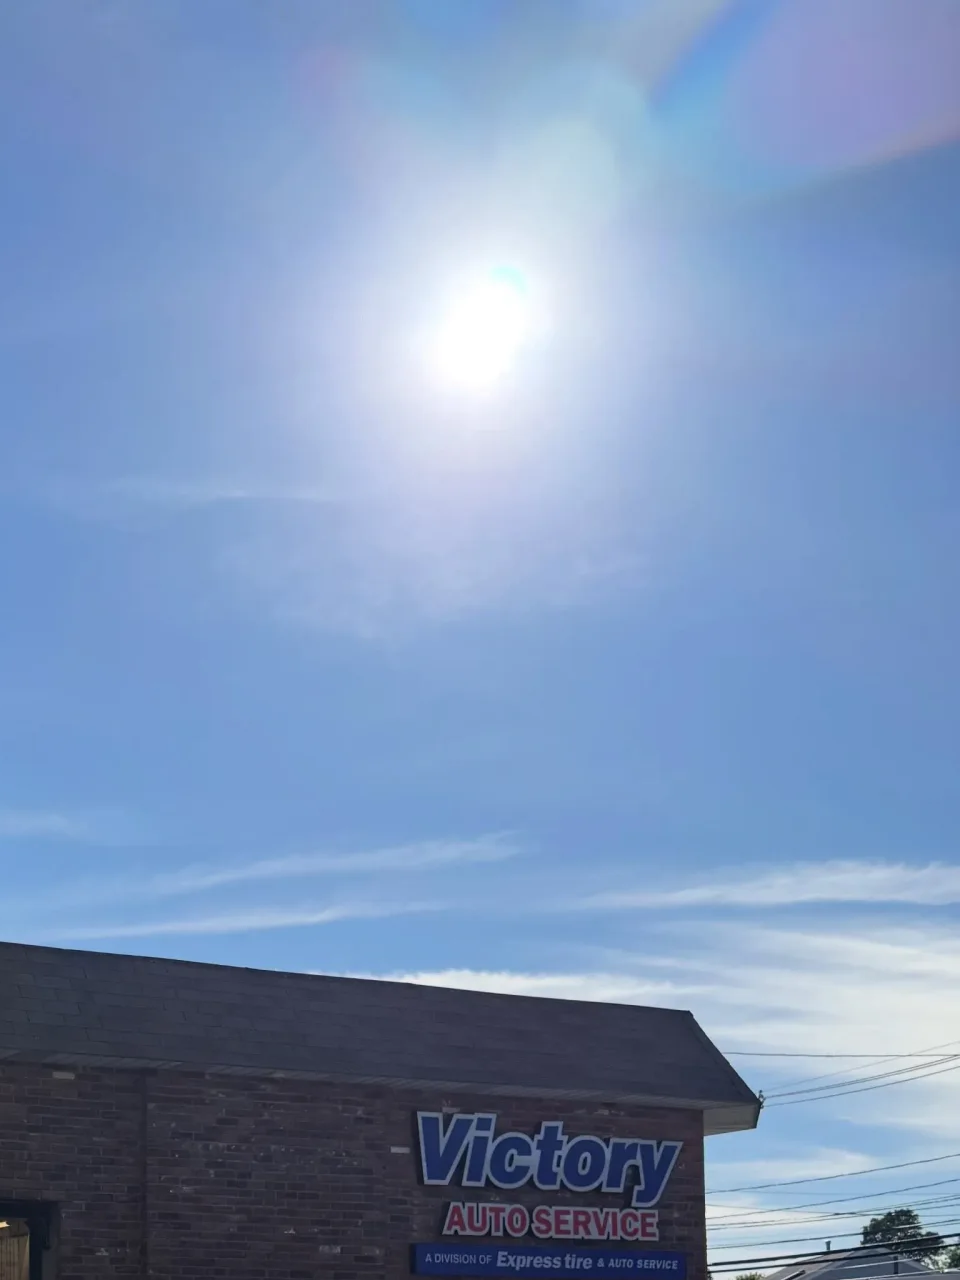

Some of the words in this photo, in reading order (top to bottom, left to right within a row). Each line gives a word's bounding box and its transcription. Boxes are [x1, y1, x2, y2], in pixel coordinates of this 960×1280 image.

[417, 1111, 683, 1208] Victory
[442, 1202, 529, 1237] AUTO
[531, 1205, 658, 1241] SERVICE
[425, 1253, 432, 1263] A
[434, 1253, 476, 1264] DIVISION
[479, 1254, 492, 1264] OF
[597, 1257, 605, 1267] &
[608, 1258, 634, 1268] AUTO
[636, 1259, 679, 1270] SERVICE
